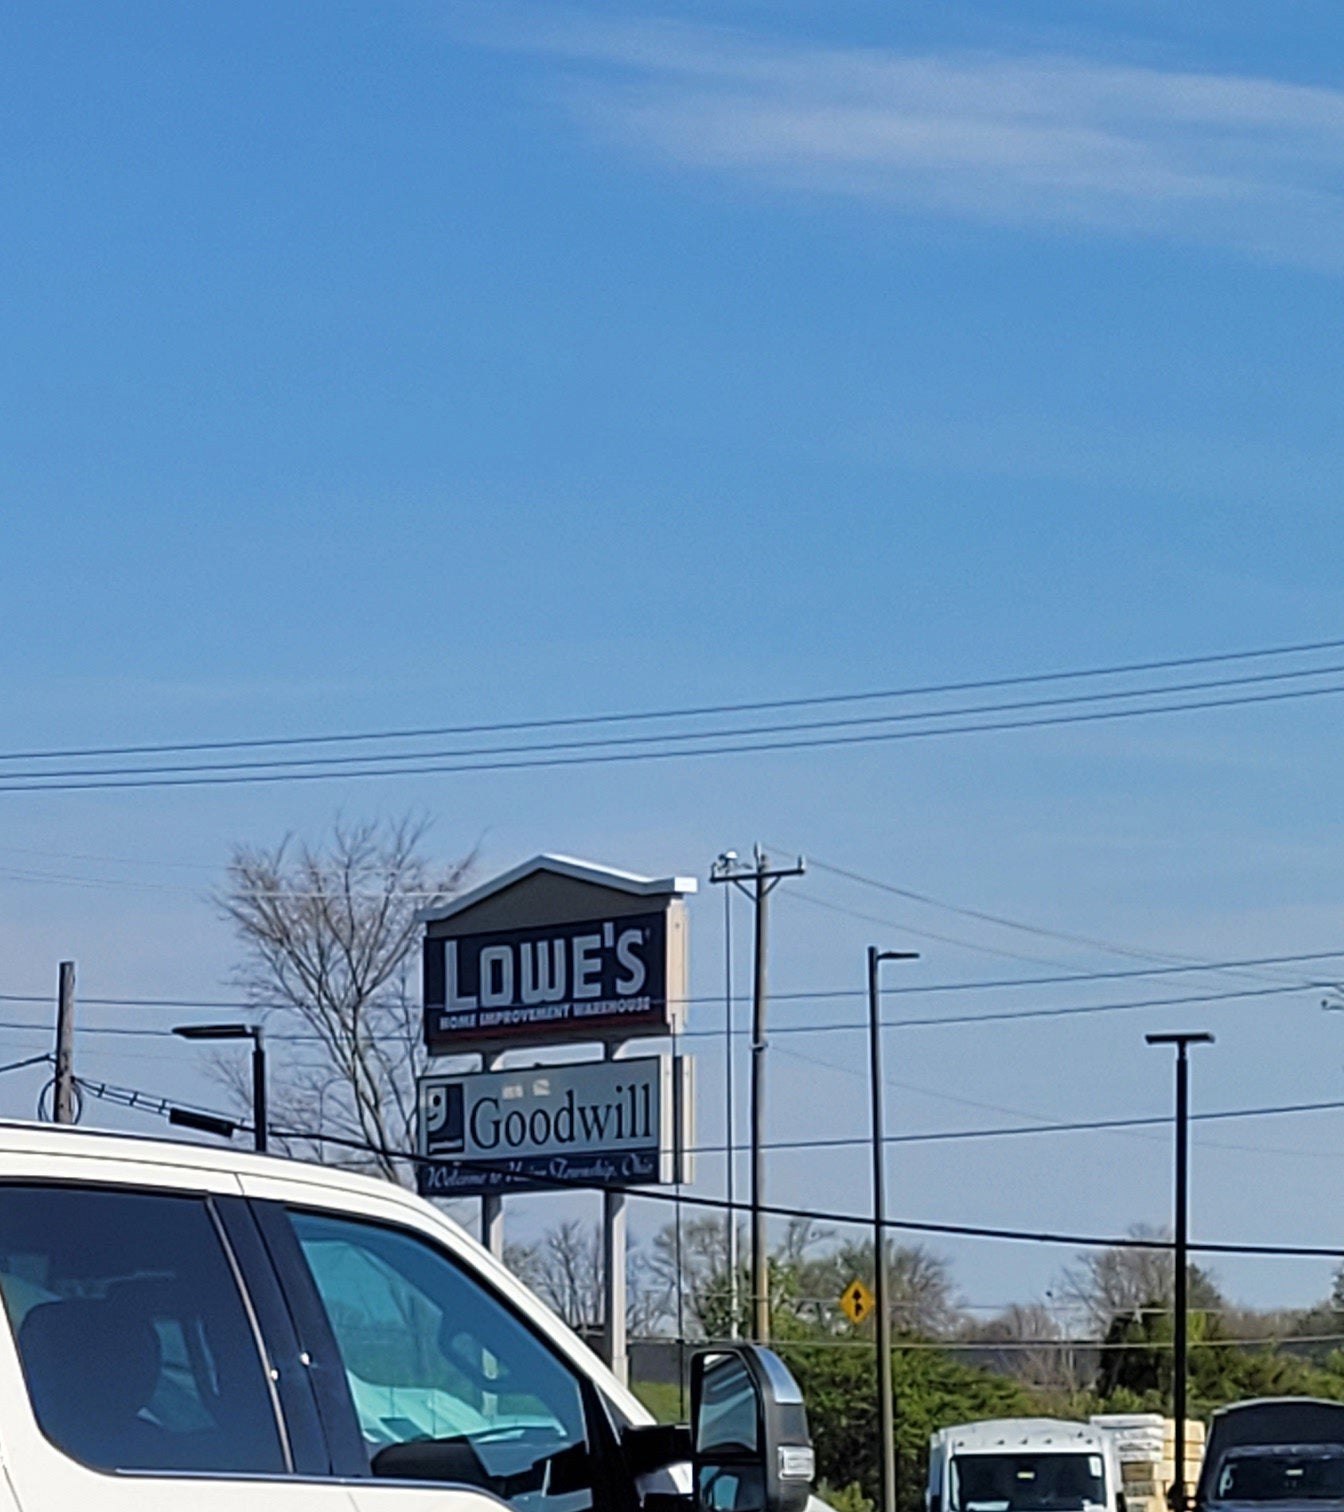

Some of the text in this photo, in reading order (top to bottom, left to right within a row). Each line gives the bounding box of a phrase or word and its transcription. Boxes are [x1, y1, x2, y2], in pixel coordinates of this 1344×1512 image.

[444, 921, 646, 1013] LOWE'S
[439, 996, 651, 1031] HOME IMPROVEMENT WAREHOUSE
[469, 1083, 653, 1150] Goodwill
